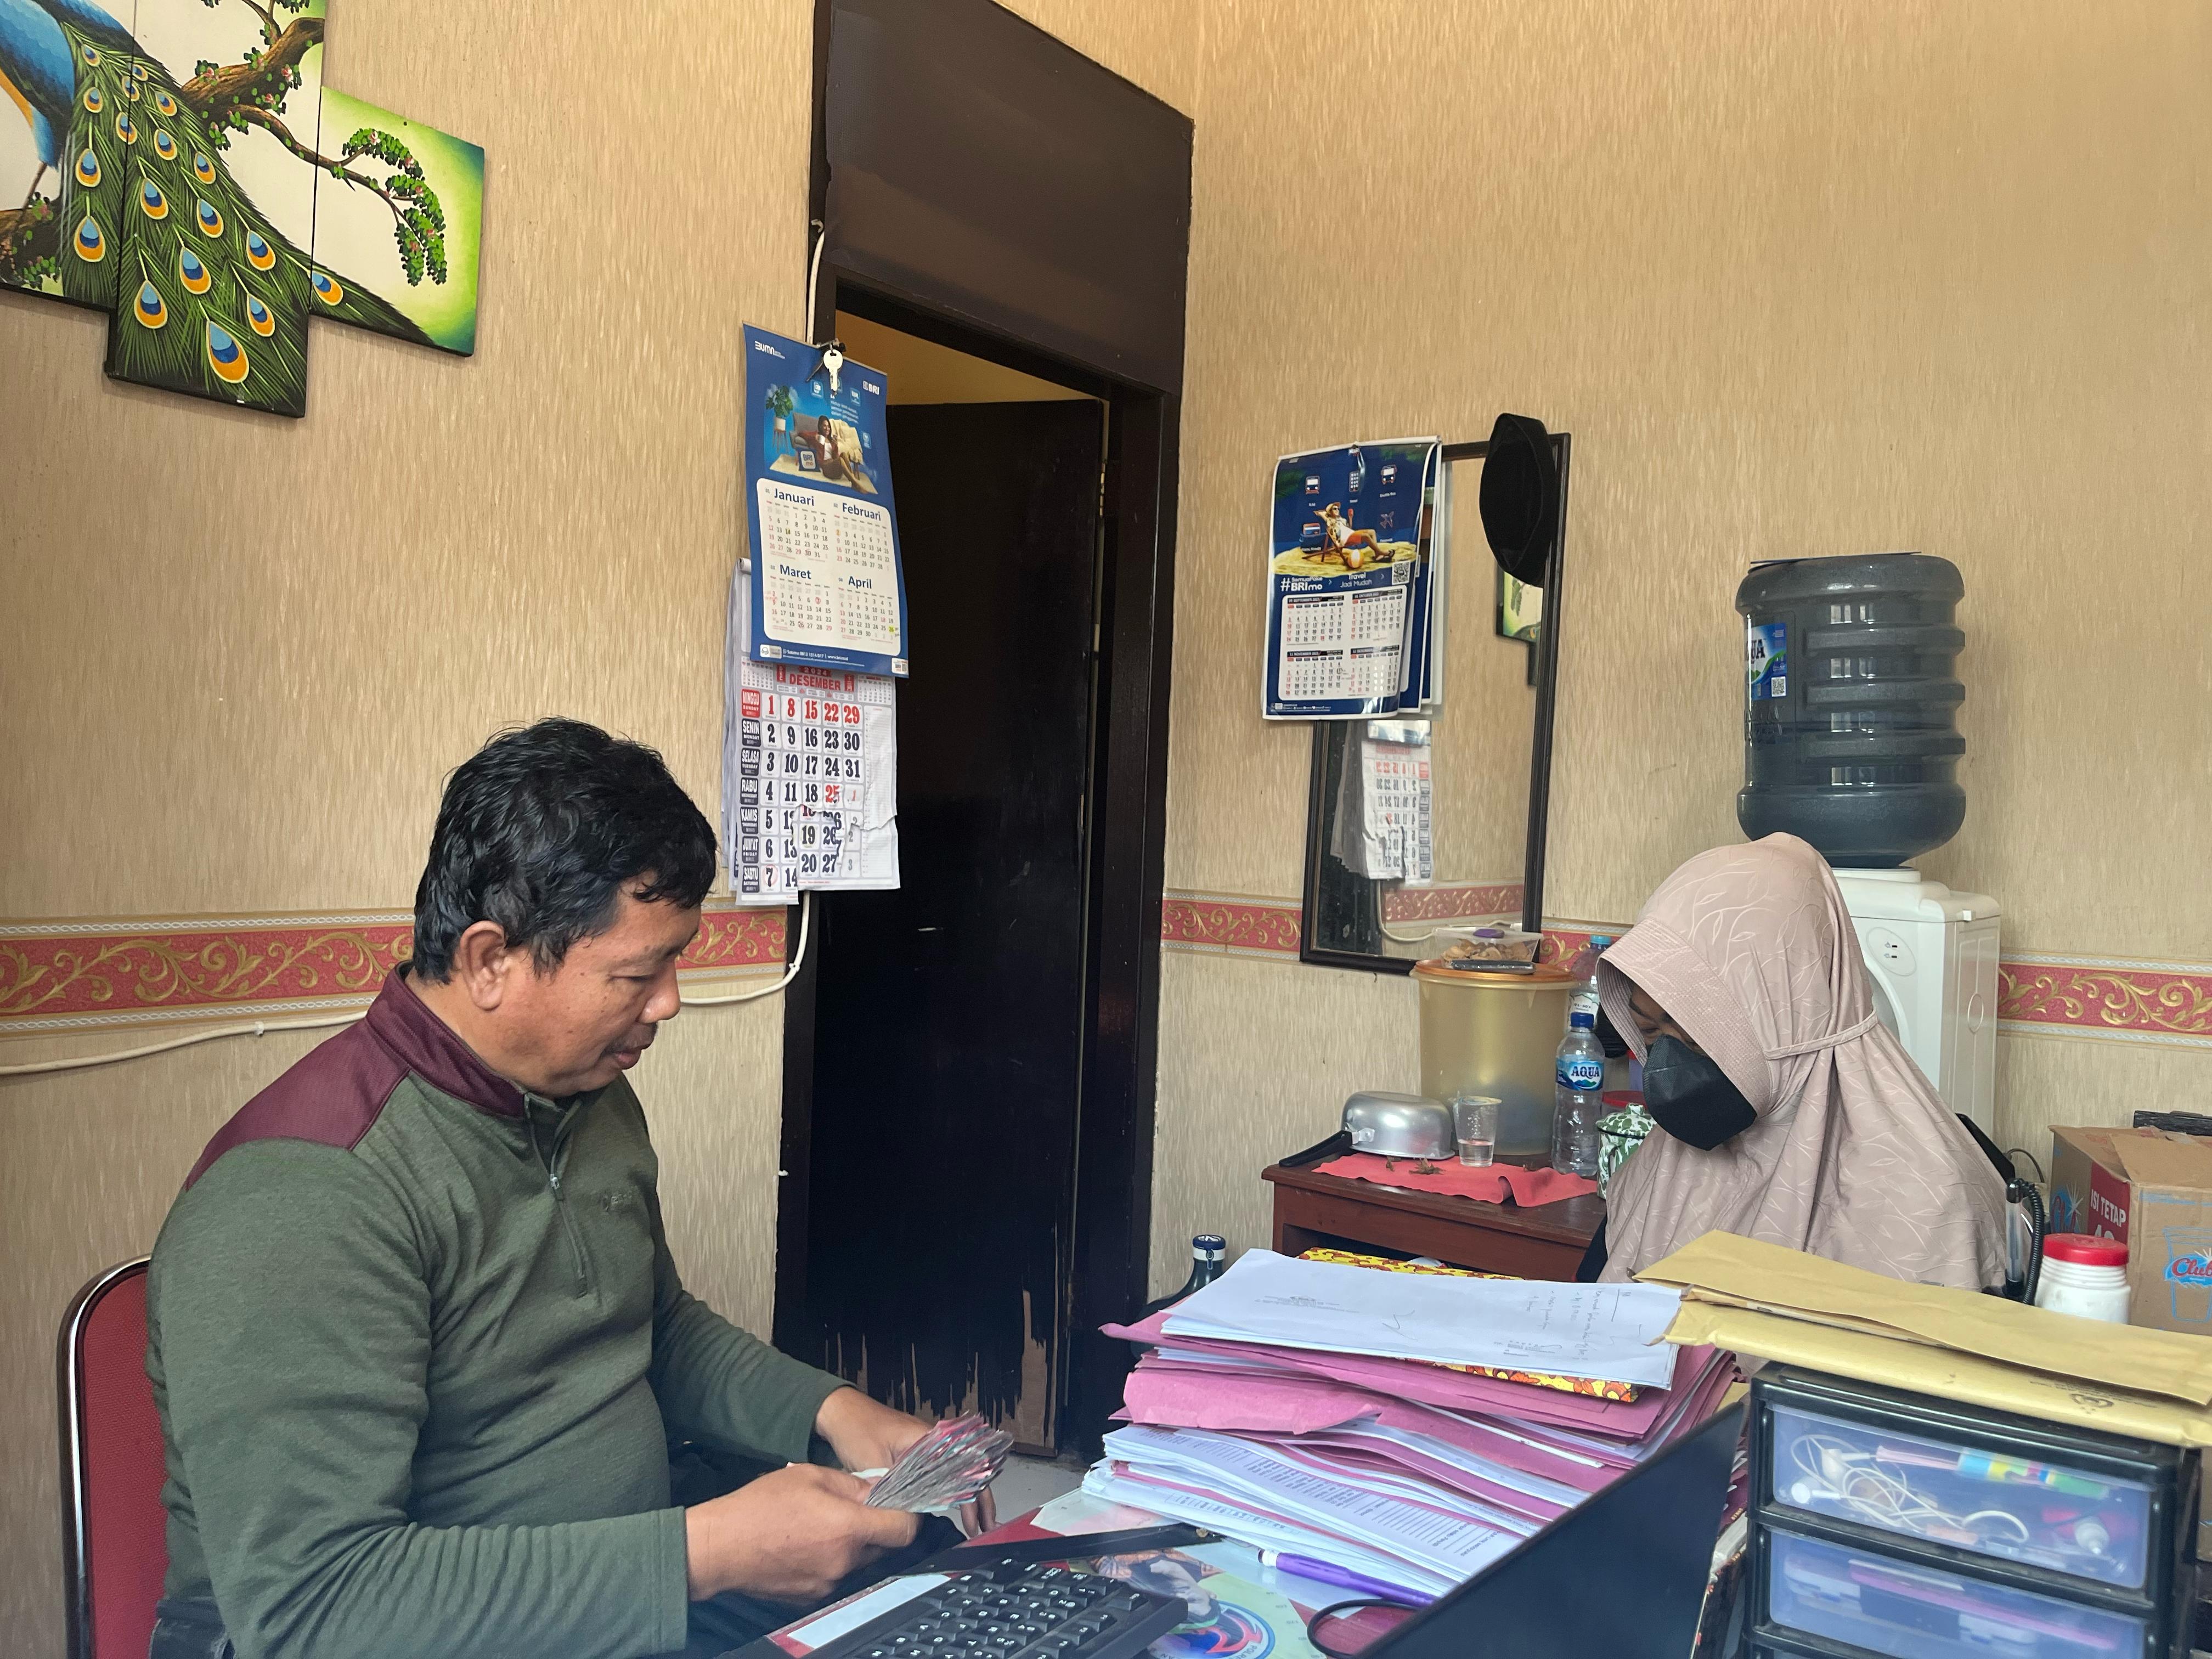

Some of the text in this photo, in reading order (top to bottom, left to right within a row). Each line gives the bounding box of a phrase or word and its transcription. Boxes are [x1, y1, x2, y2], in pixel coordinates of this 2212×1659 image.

[868, 383, 879, 395] BRI
[803, 454, 812, 462] BRI
[774, 488, 814, 506] Januari
[843, 503, 881, 521] Februari
[780, 565, 811, 580] Maret
[1348, 572, 1366, 580] Travel
[849, 576, 872, 589] April
[1353, 579, 1372, 587] Mudah
[804, 667, 827, 676] 2024
[789, 674, 840, 690] DESEMBER
[743, 691, 760, 706] MINGGU
[769, 695, 774, 714] 1
[788, 698, 795, 717] 8
[805, 700, 817, 719] 15
[825, 703, 839, 722] 22
[844, 706, 860, 724] 29
[743, 720, 860, 751] SENIN 2 9 16 23 30
[742, 749, 860, 777] SELASA 3 10 17 24 31
[742, 780, 757, 793] RABU
[766, 781, 772, 800] 4
[785, 782, 797, 801] 11
[805, 783, 818, 802] 18
[741, 809, 757, 821] KAMIS
[766, 810, 772, 829] 5
[802, 825, 815, 844] 19
[849, 831, 853, 842] 2
[743, 838, 758, 850] JUM'AT
[766, 839, 772, 857] 6
[802, 854, 853, 873] 20 27 3
[744, 867, 798, 887] SABTU 7 14
[1571, 1066, 1600, 1079] AQUA
[2090, 1189, 2100, 1212] ISI
[2101, 1198, 2127, 1227] TETAP
